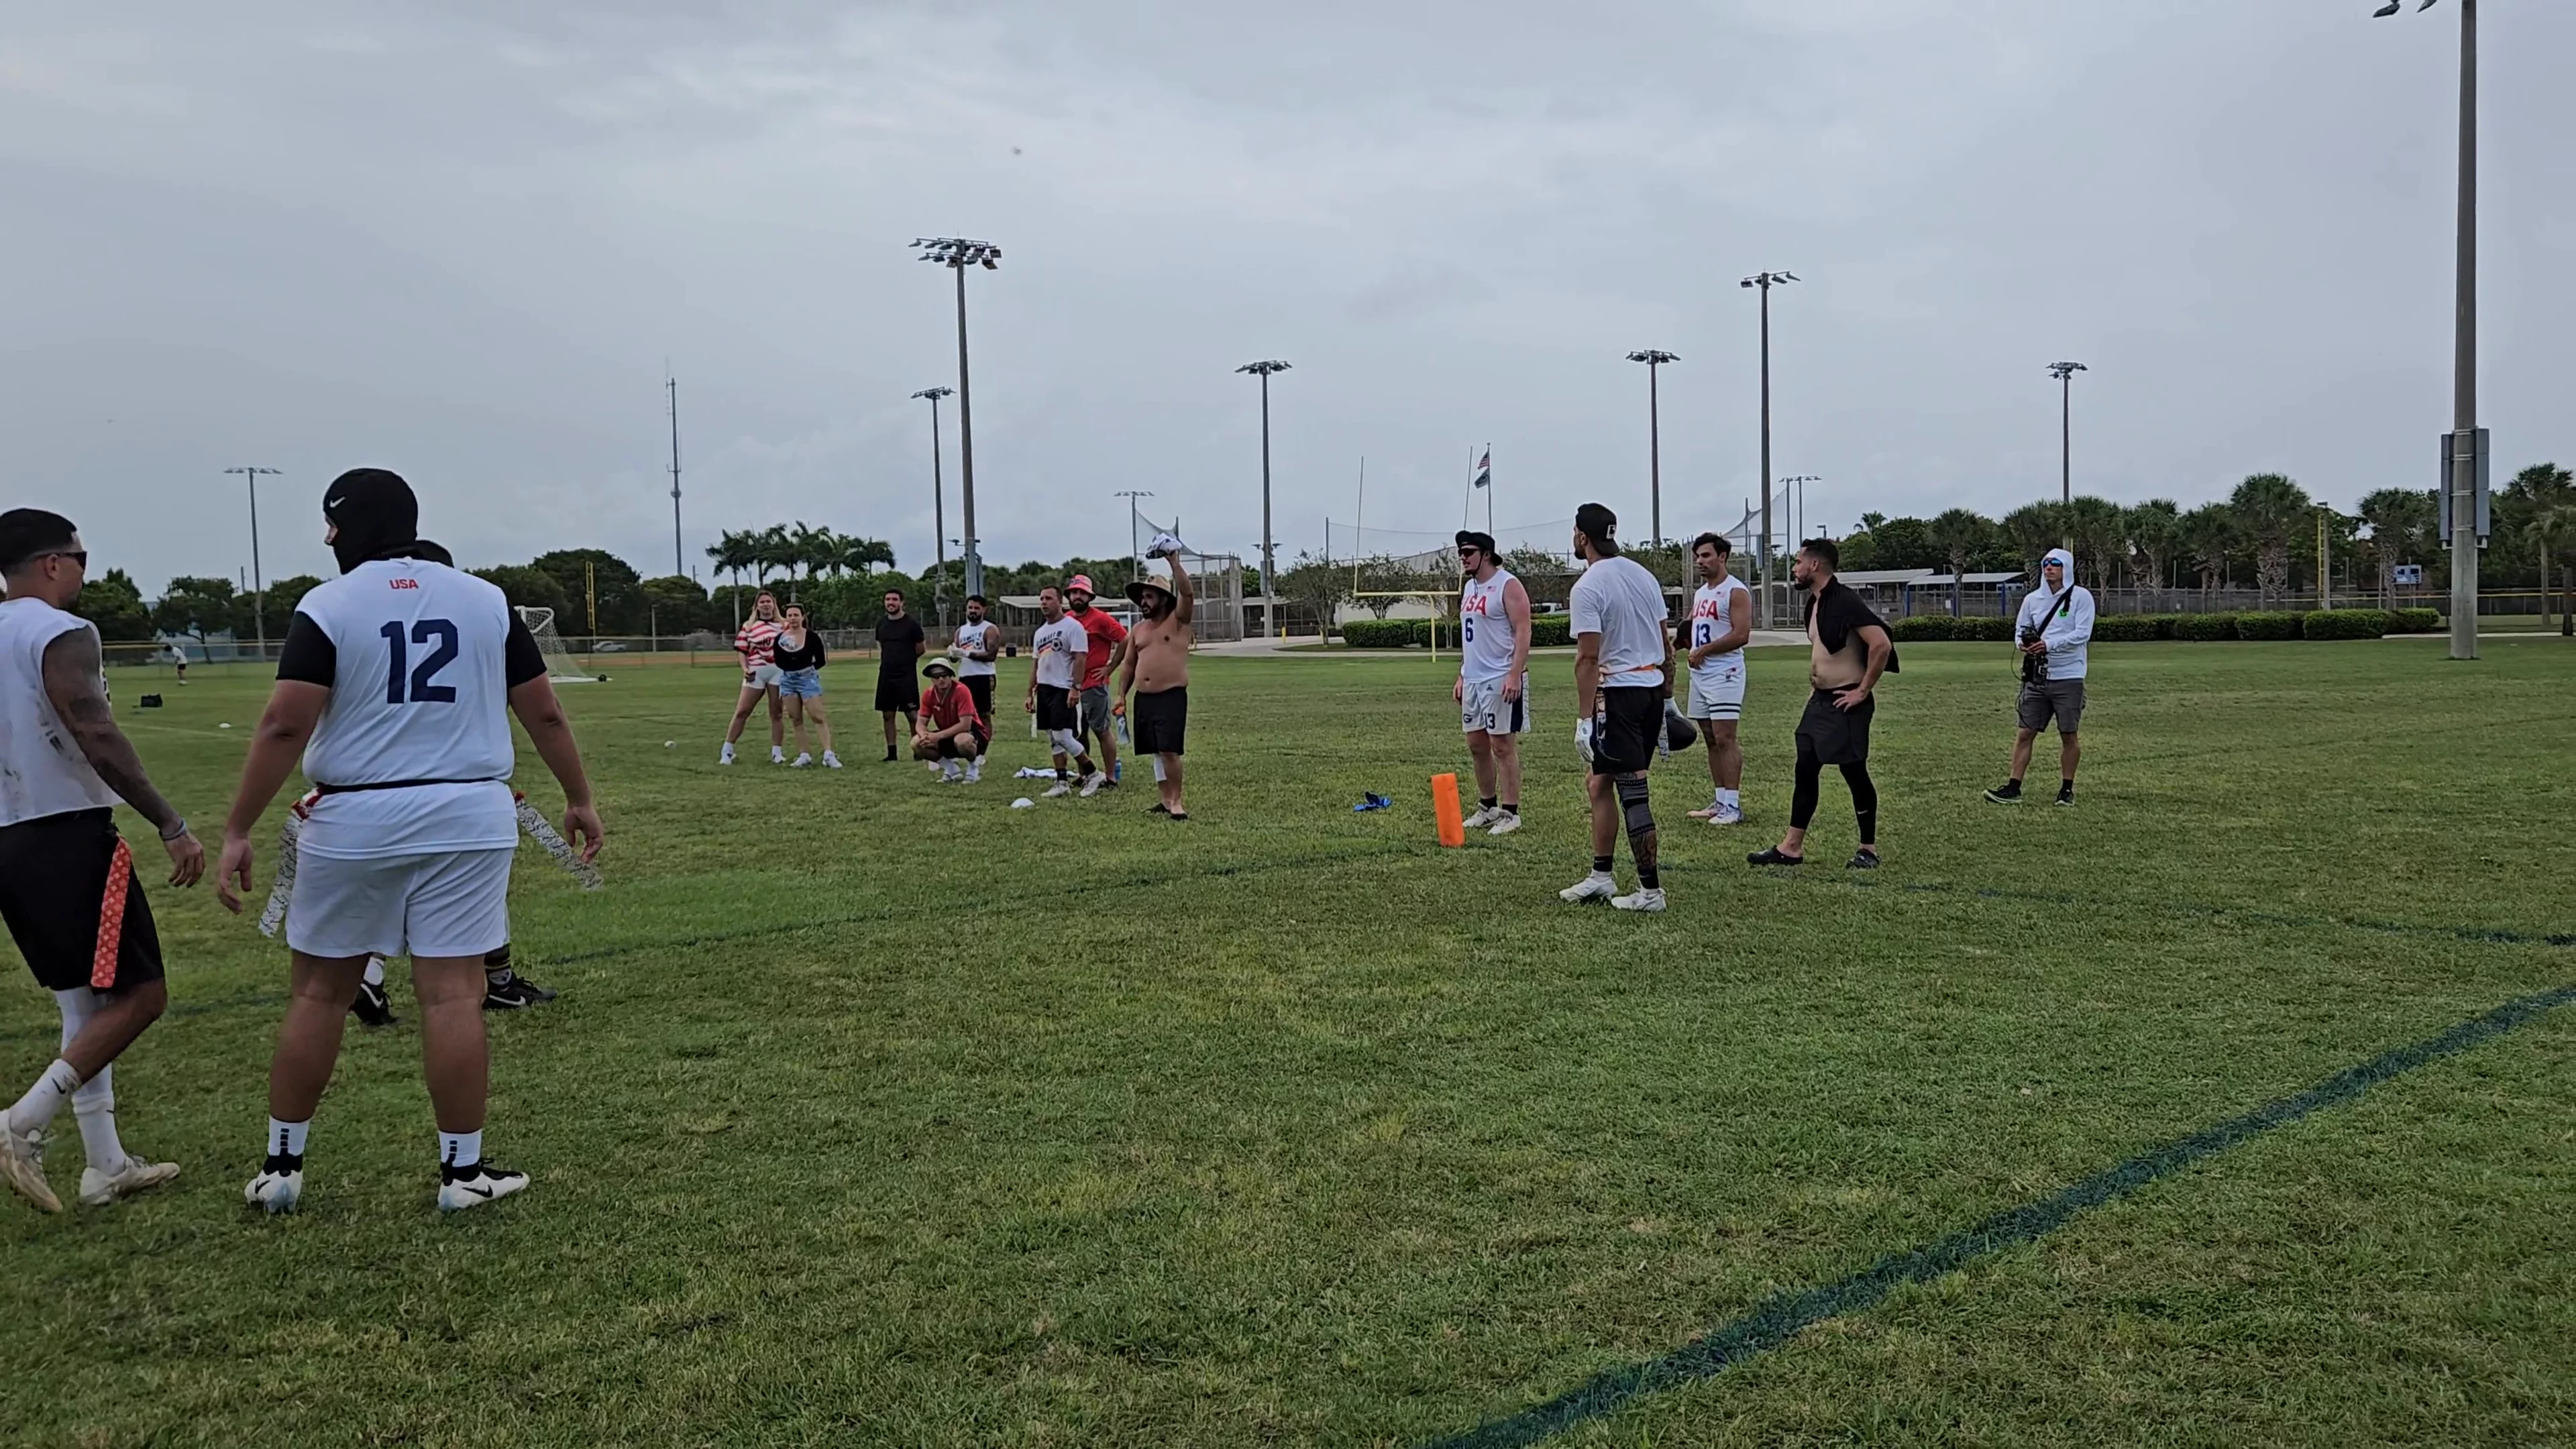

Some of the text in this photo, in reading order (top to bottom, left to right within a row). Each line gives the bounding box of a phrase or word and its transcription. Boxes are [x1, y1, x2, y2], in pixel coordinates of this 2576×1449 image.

[389, 579, 419, 590] USA
[1465, 617, 1474, 642] 6
[1695, 623, 1711, 648] 13
[380, 619, 459, 704] 12
[1463, 713, 1472, 723] G
[1484, 712, 1495, 729] 13
